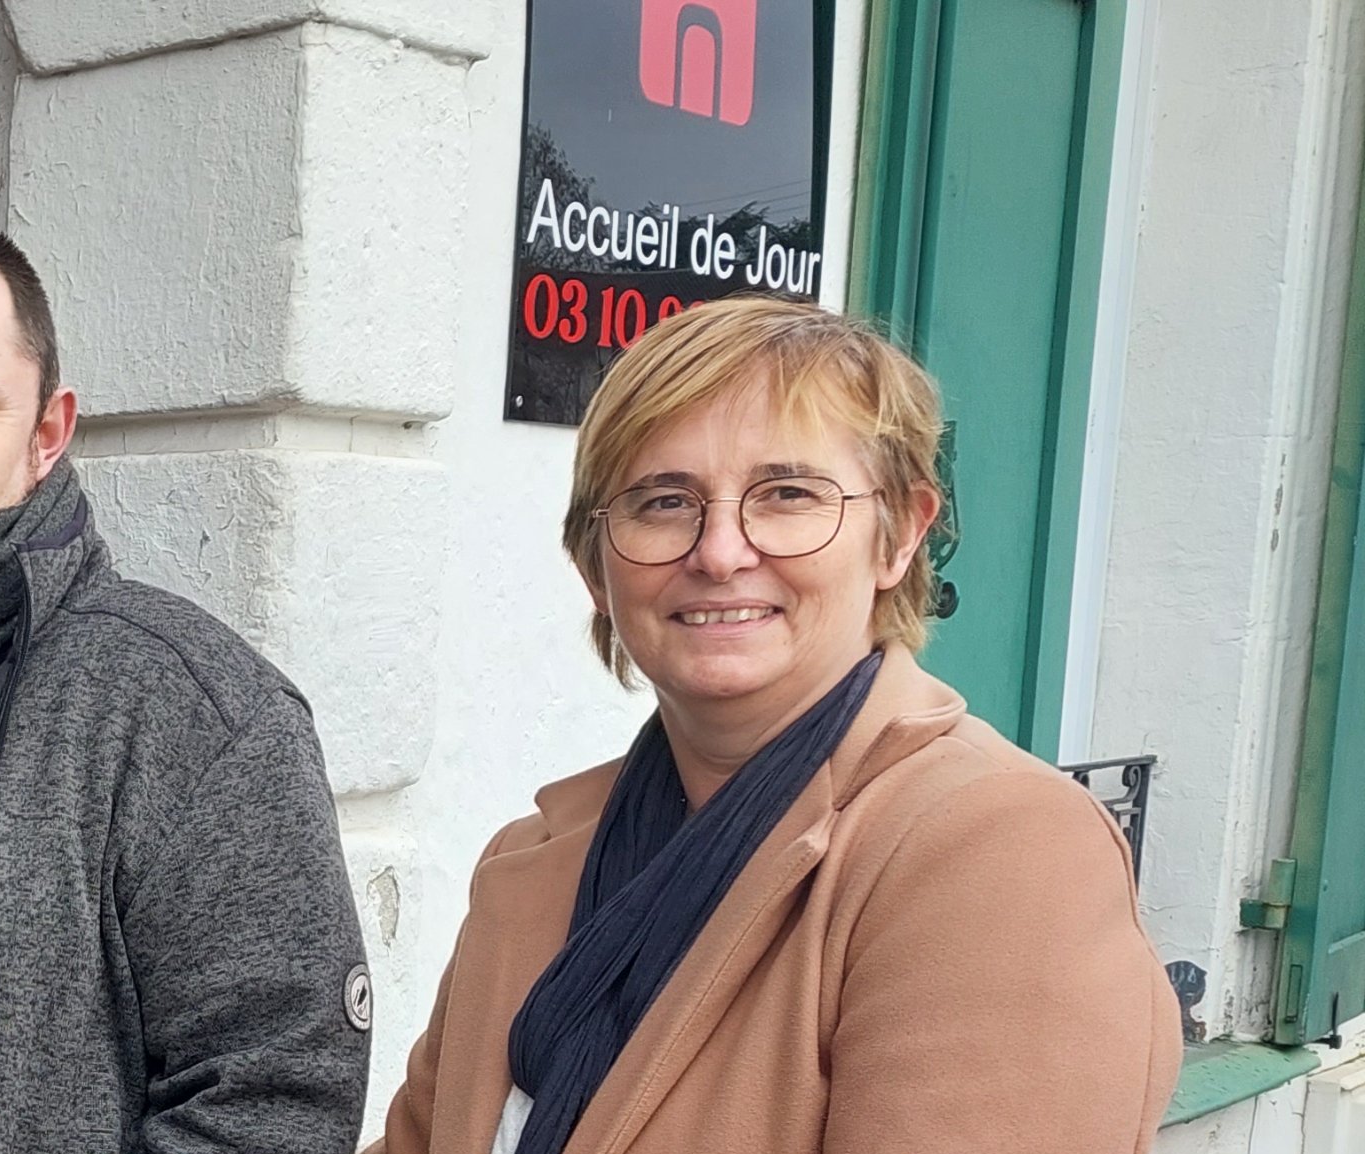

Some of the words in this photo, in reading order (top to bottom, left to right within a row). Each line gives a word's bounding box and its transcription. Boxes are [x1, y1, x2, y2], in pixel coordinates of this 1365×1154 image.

[526, 178, 680, 269] Accueil
[690, 213, 736, 279] de
[745, 225, 821, 295] Jour
[524, 273, 588, 344] 03
[597, 286, 648, 349] 10
